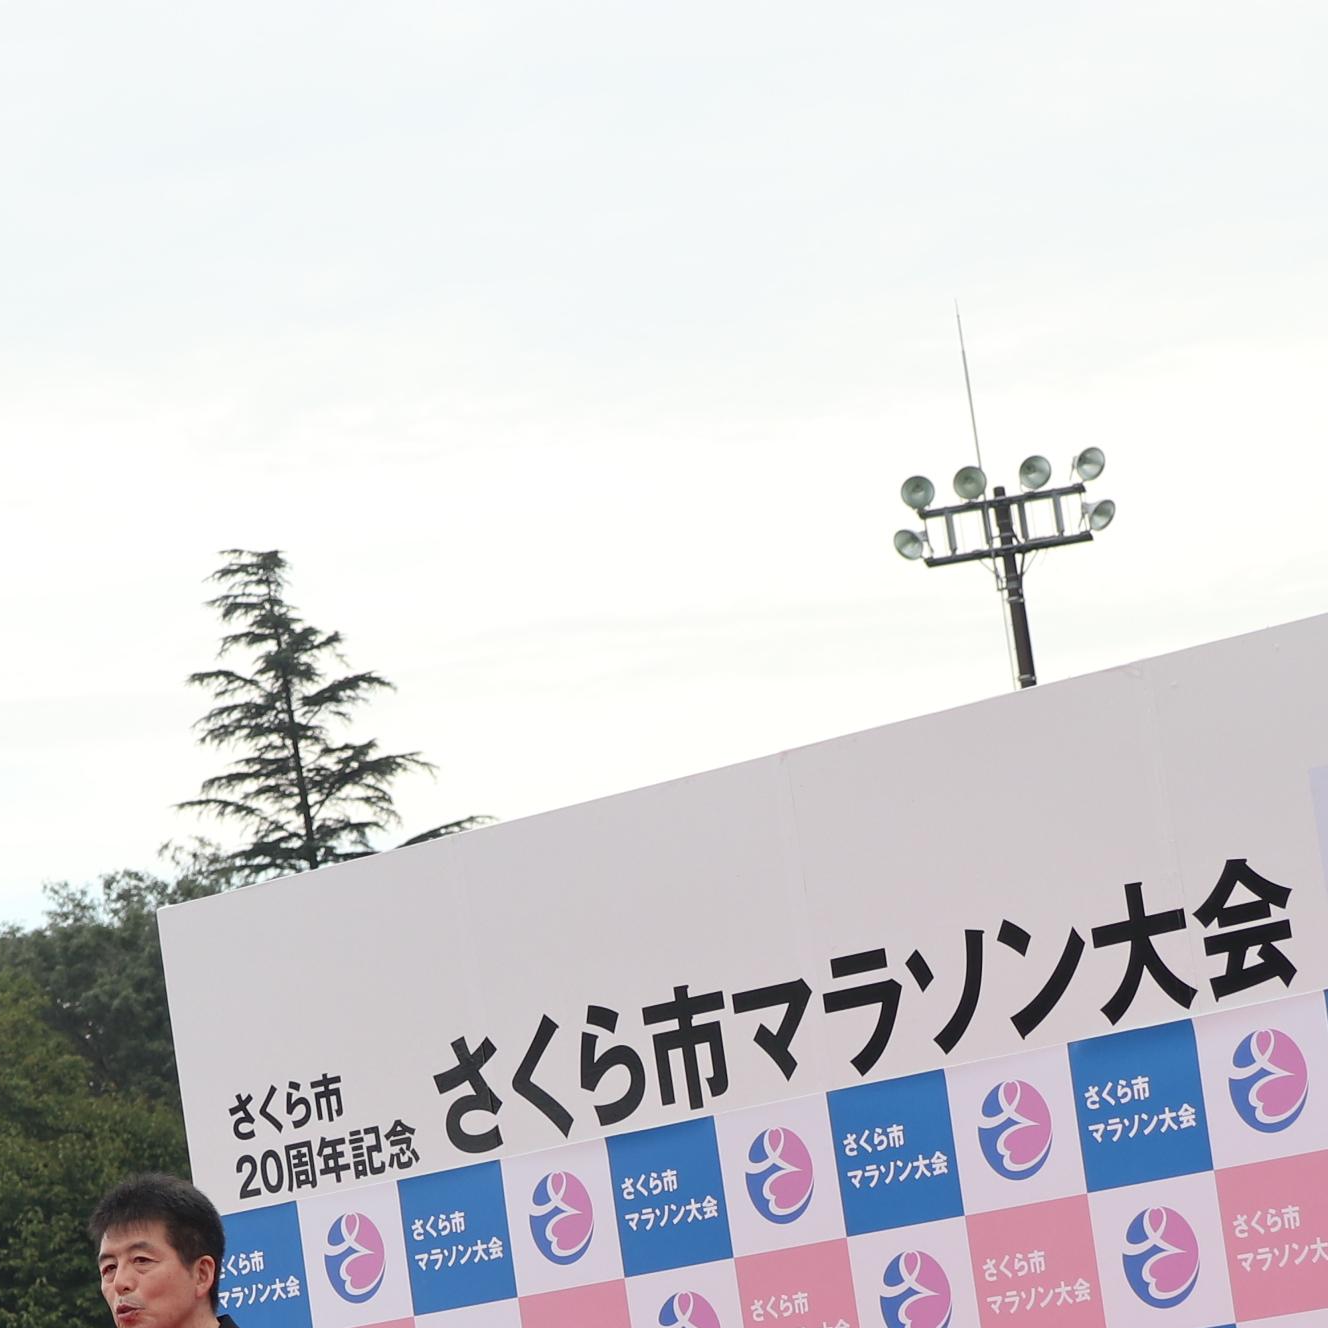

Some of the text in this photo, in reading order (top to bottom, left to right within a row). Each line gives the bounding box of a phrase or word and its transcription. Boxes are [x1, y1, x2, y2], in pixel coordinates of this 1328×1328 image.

[432, 858, 1299, 1155] さくら市マラソン大会
[228, 1073, 344, 1141] さくら市
[1085, 1075, 1150, 1110] さくら市
[1089, 1103, 1196, 1142] マラソン大会
[842, 1124, 905, 1157] さくら市
[235, 1119, 421, 1200] 20周年記念
[847, 1151, 949, 1188] マラソン大会
[621, 1169, 678, 1200] さくら市
[412, 1211, 466, 1241] さくら市
[624, 1195, 719, 1230] マラソン大会
[1232, 1205, 1302, 1239] さくら市
[415, 1236, 504, 1270] マラソン大会
[983, 1250, 1047, 1281] さくら市
[218, 1276, 300, 1308] マラソン大会
[751, 1290, 809, 1322] さくら市
[987, 1278, 1092, 1313] マラソン大会
